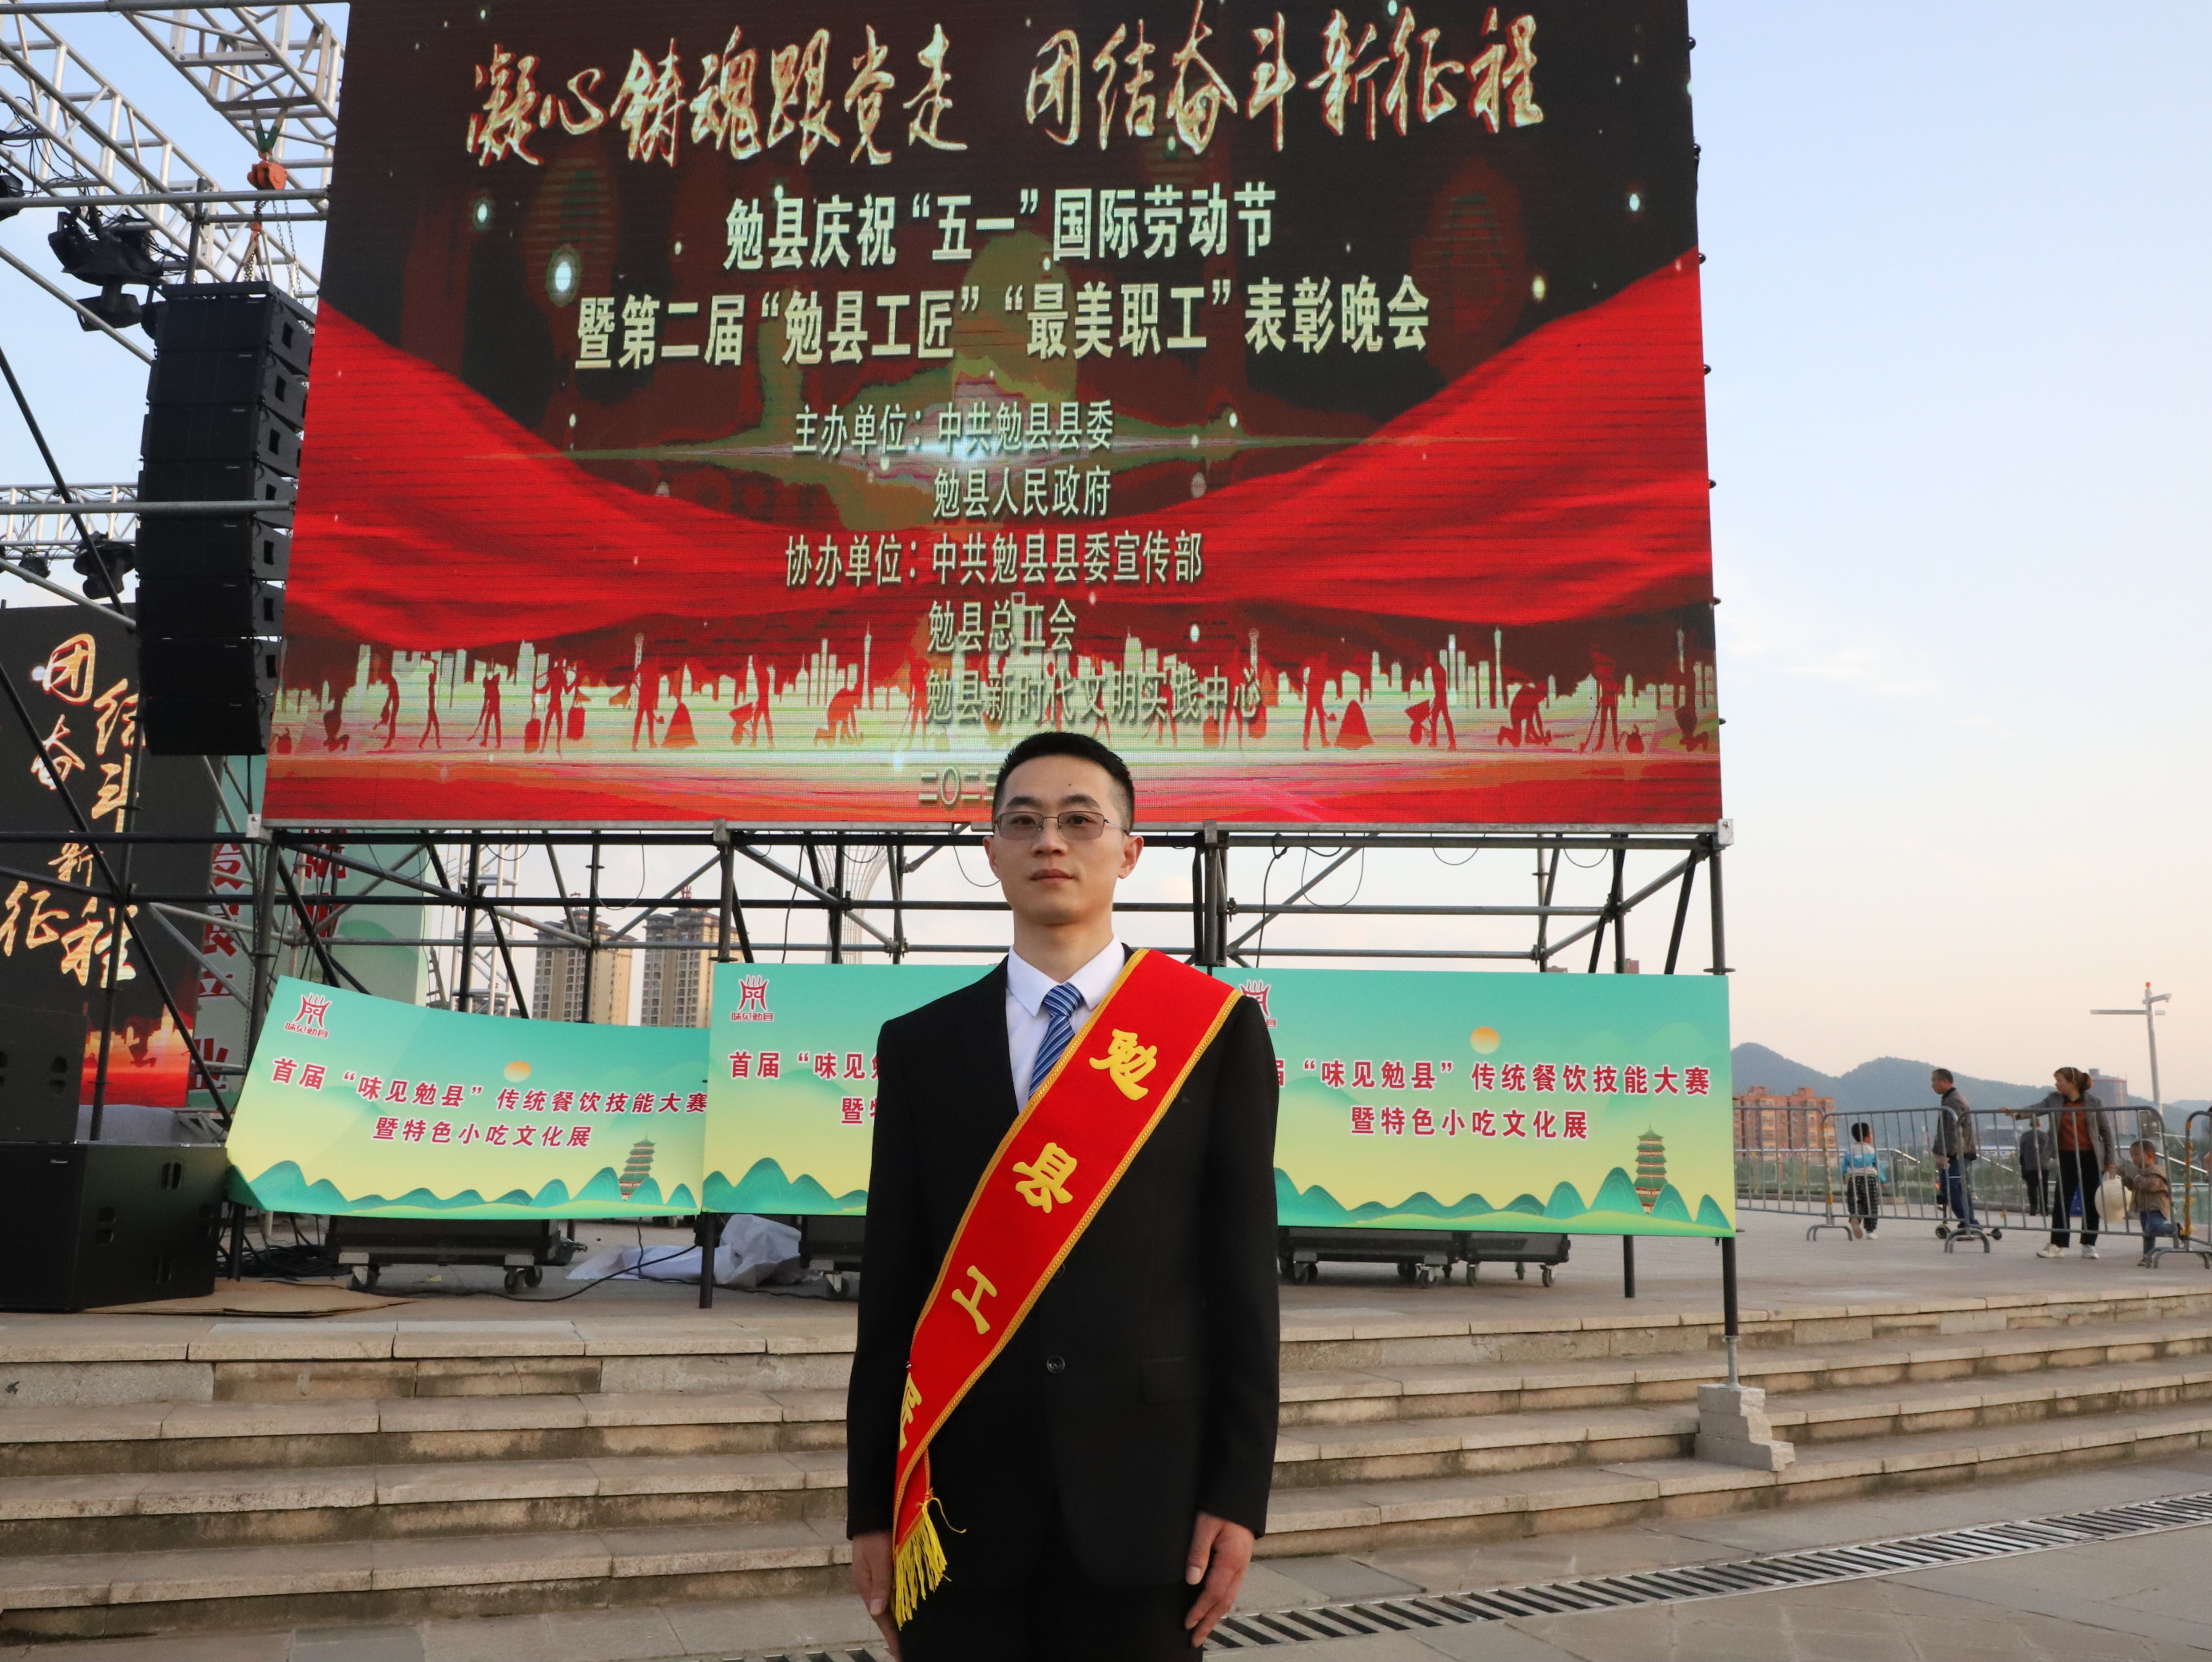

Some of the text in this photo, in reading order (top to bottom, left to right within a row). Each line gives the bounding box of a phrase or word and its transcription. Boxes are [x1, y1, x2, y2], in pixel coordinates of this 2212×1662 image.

[467, 0, 1544, 167] 凝心铸魂跟党走 团结奋斗新征程
[933, 464, 1111, 519] 勉县人民政府
[927, 598, 1076, 653] 勉县总工会
[925, 665, 1263, 724] 勉县新时代文明实践中心
[372, 1116, 593, 1148] 暨特色小吃文化展
[841, 1097, 877, 1124] 暨
[1351, 1105, 1588, 1140] 暨特色小吃文化展
